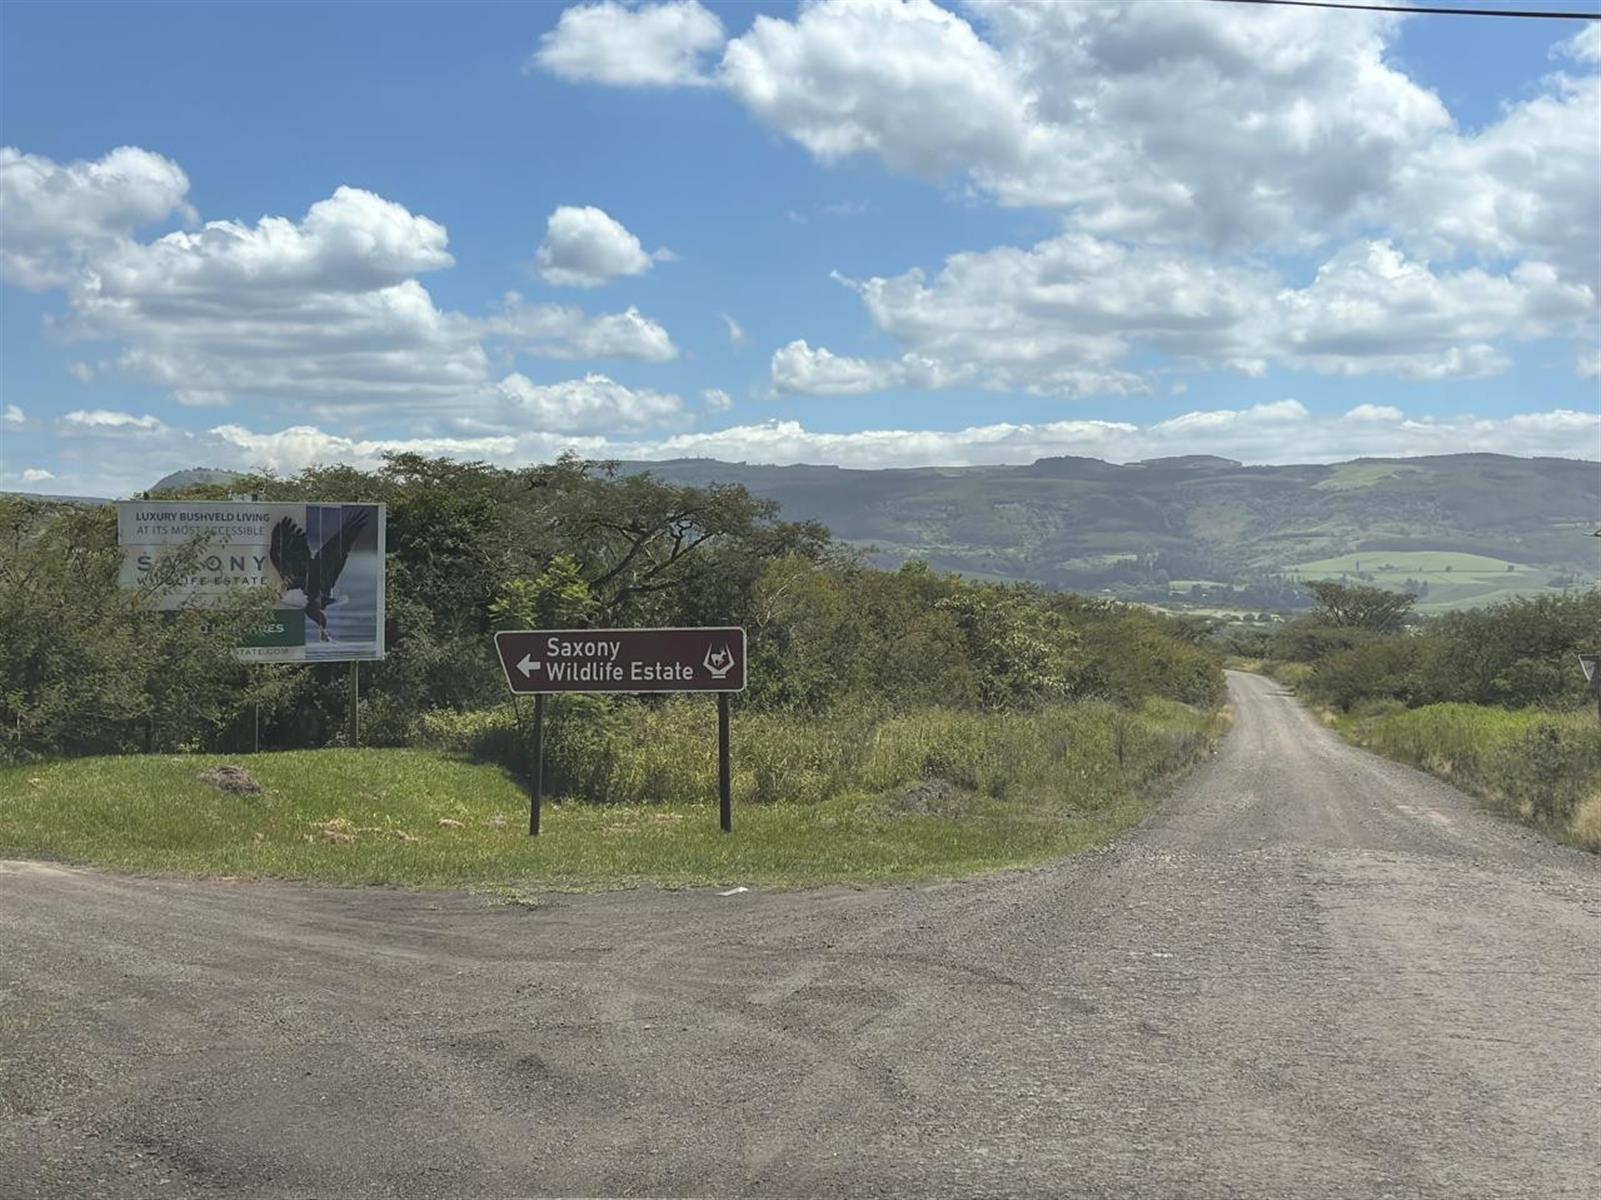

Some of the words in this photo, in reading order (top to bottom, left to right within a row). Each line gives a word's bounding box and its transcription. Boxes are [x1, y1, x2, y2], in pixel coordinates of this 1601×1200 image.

[135, 512, 178, 522] LUXURY
[179, 512, 234, 522] BUSHVELD
[236, 512, 271, 523] LIVING
[136, 525, 149, 536] AT
[152, 525, 168, 536] ITS
[170, 525, 201, 536] MOST
[204, 525, 265, 537] ACCESSIBLE
[136, 555, 267, 572] SAONY
[136, 576, 208, 587] WIDLIFE
[213, 576, 268, 586] ESTATE
[547, 637, 621, 661] Saxony
[546, 662, 624, 682] Wildlife
[631, 661, 694, 681] Estate
